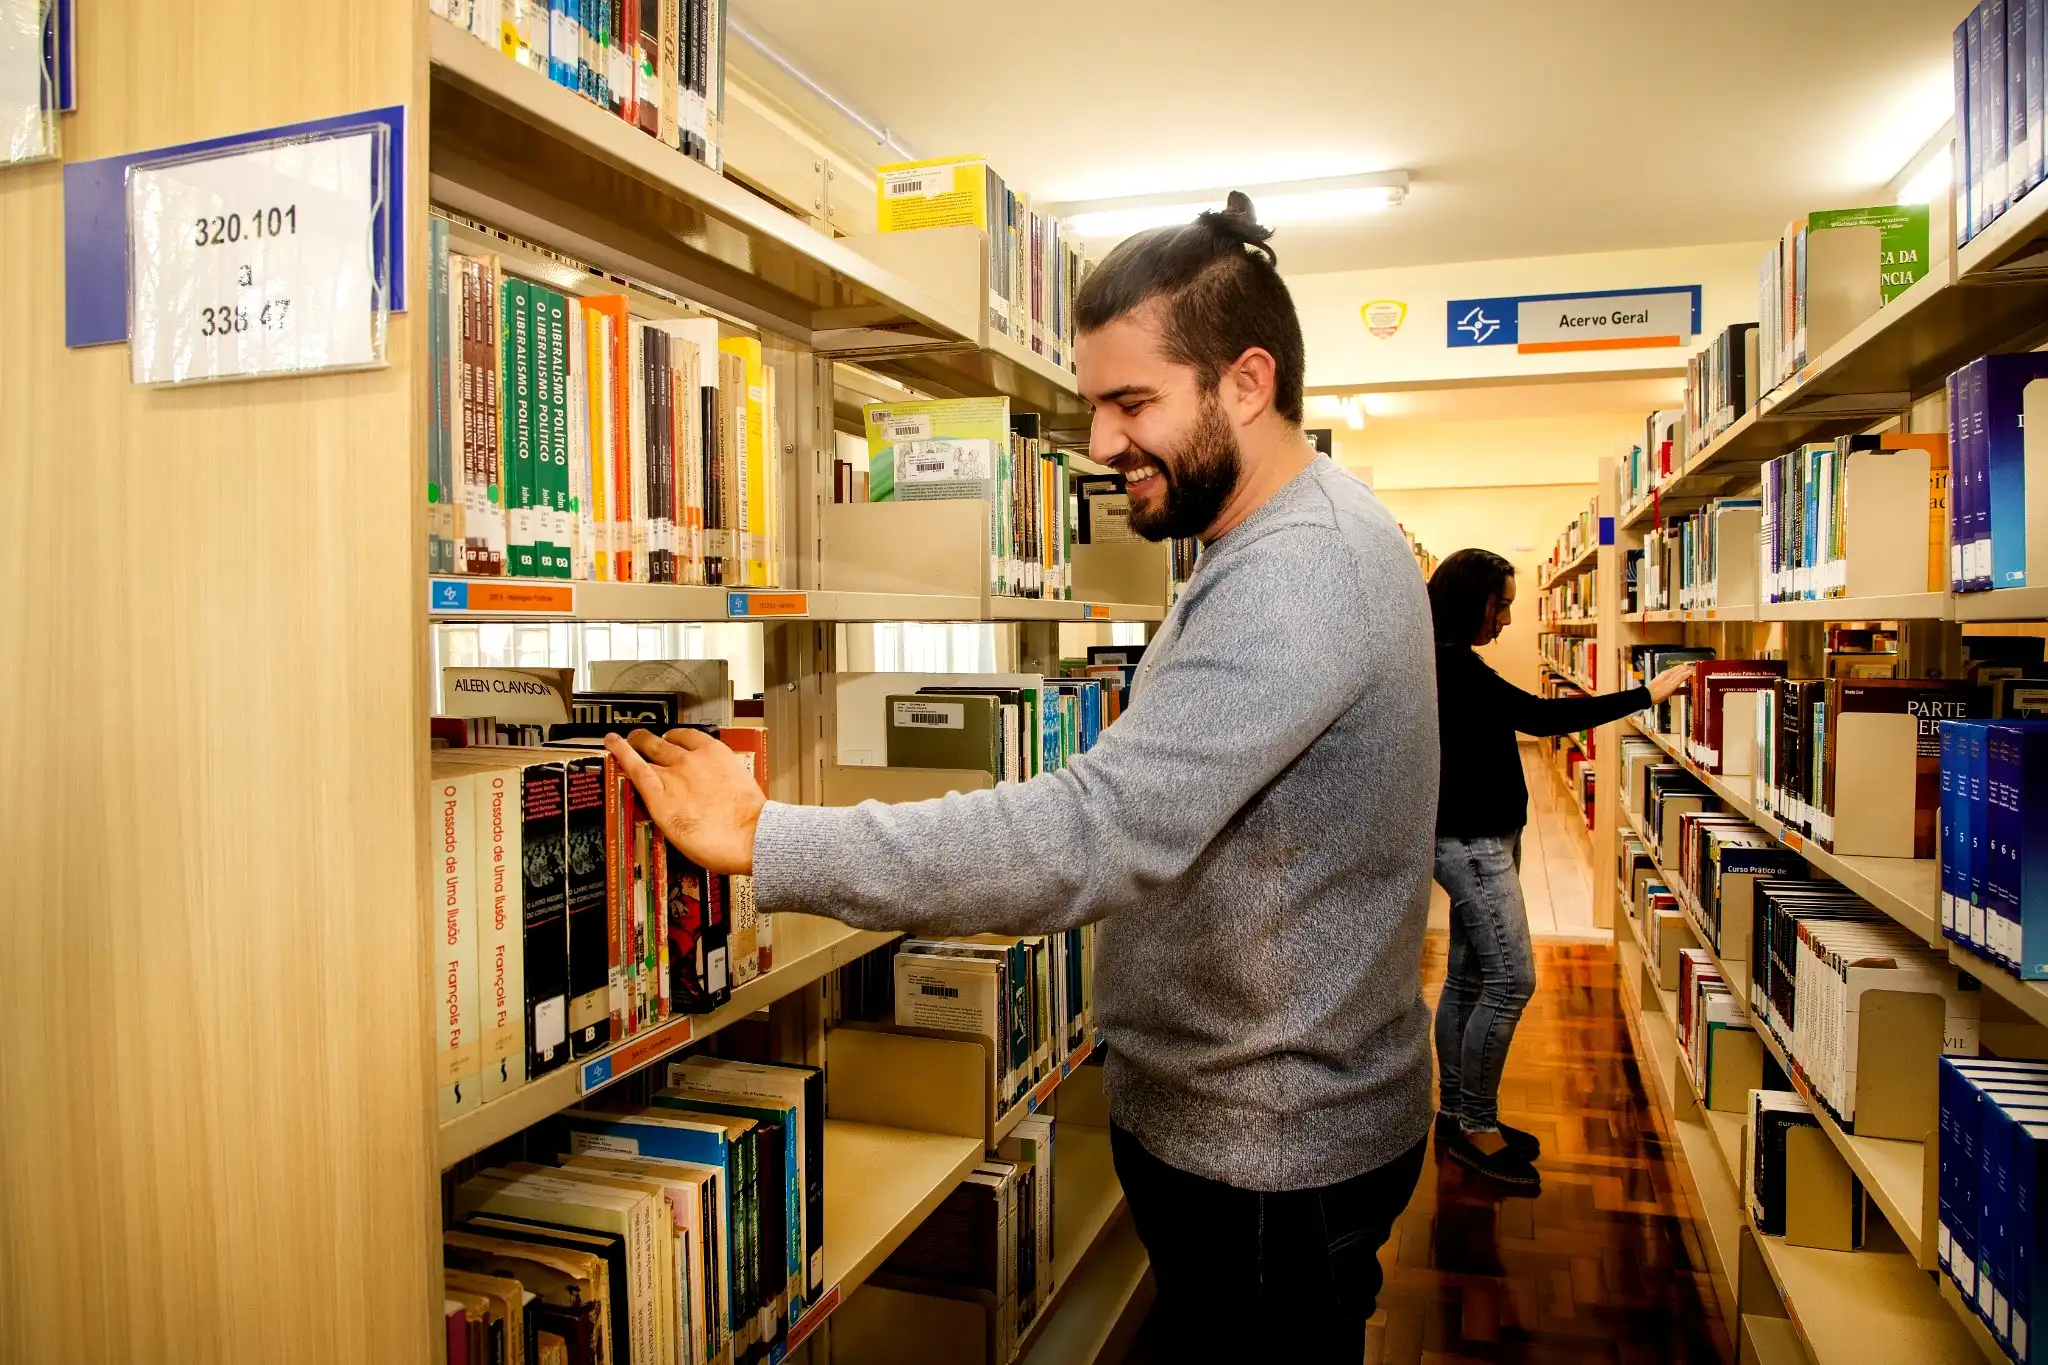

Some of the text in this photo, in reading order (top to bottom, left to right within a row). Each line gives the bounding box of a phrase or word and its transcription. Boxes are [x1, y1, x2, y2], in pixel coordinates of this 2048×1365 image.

[195, 204, 296, 247] 320.101
[1898, 249, 1918, 264] DA
[238, 264, 252, 287] a
[1559, 309, 1648, 328] Acervo Geral
[464, 363, 472, 401] DIREITO
[516, 295, 530, 504] O LIBERALISMO POLÍTICO John
[536, 302, 550, 506] O LIBERALISMO POLÍTICO John
[552, 308, 566, 508] O LIBERALISMO POLÍTICO John
[1978, 470, 1982, 482] 4
[454, 678, 552, 696] AILEEN CLAWSON
[1907, 700, 1967, 718] PARTE
[444, 786, 457, 796] O
[492, 778, 503, 788] O
[444, 800, 458, 852] Passado
[492, 792, 504, 842] Passado
[1944, 826, 1949, 836] 5
[1960, 832, 1964, 842] 5
[1973, 837, 1978, 848] 5
[1990, 840, 1996, 850] 6
[2001, 844, 2006, 854] 6
[493, 845, 504, 862] de
[2012, 850, 2016, 860] 6
[446, 856, 458, 874] de
[1750, 866, 1776, 874] Prático
[494, 864, 504, 892] Uma
[446, 877, 458, 906] Uma
[573, 885, 587, 895] LIVRO
[576, 890, 605, 903] COMUNISMO
[532, 897, 546, 908] LIVRO
[546, 892, 564, 904] NEGRO
[494, 896, 507, 930] Ilusão
[534, 903, 564, 917] COMUNISMO
[446, 908, 460, 945] Ilusão
[494, 945, 507, 1007] François
[446, 960, 460, 1025] François
